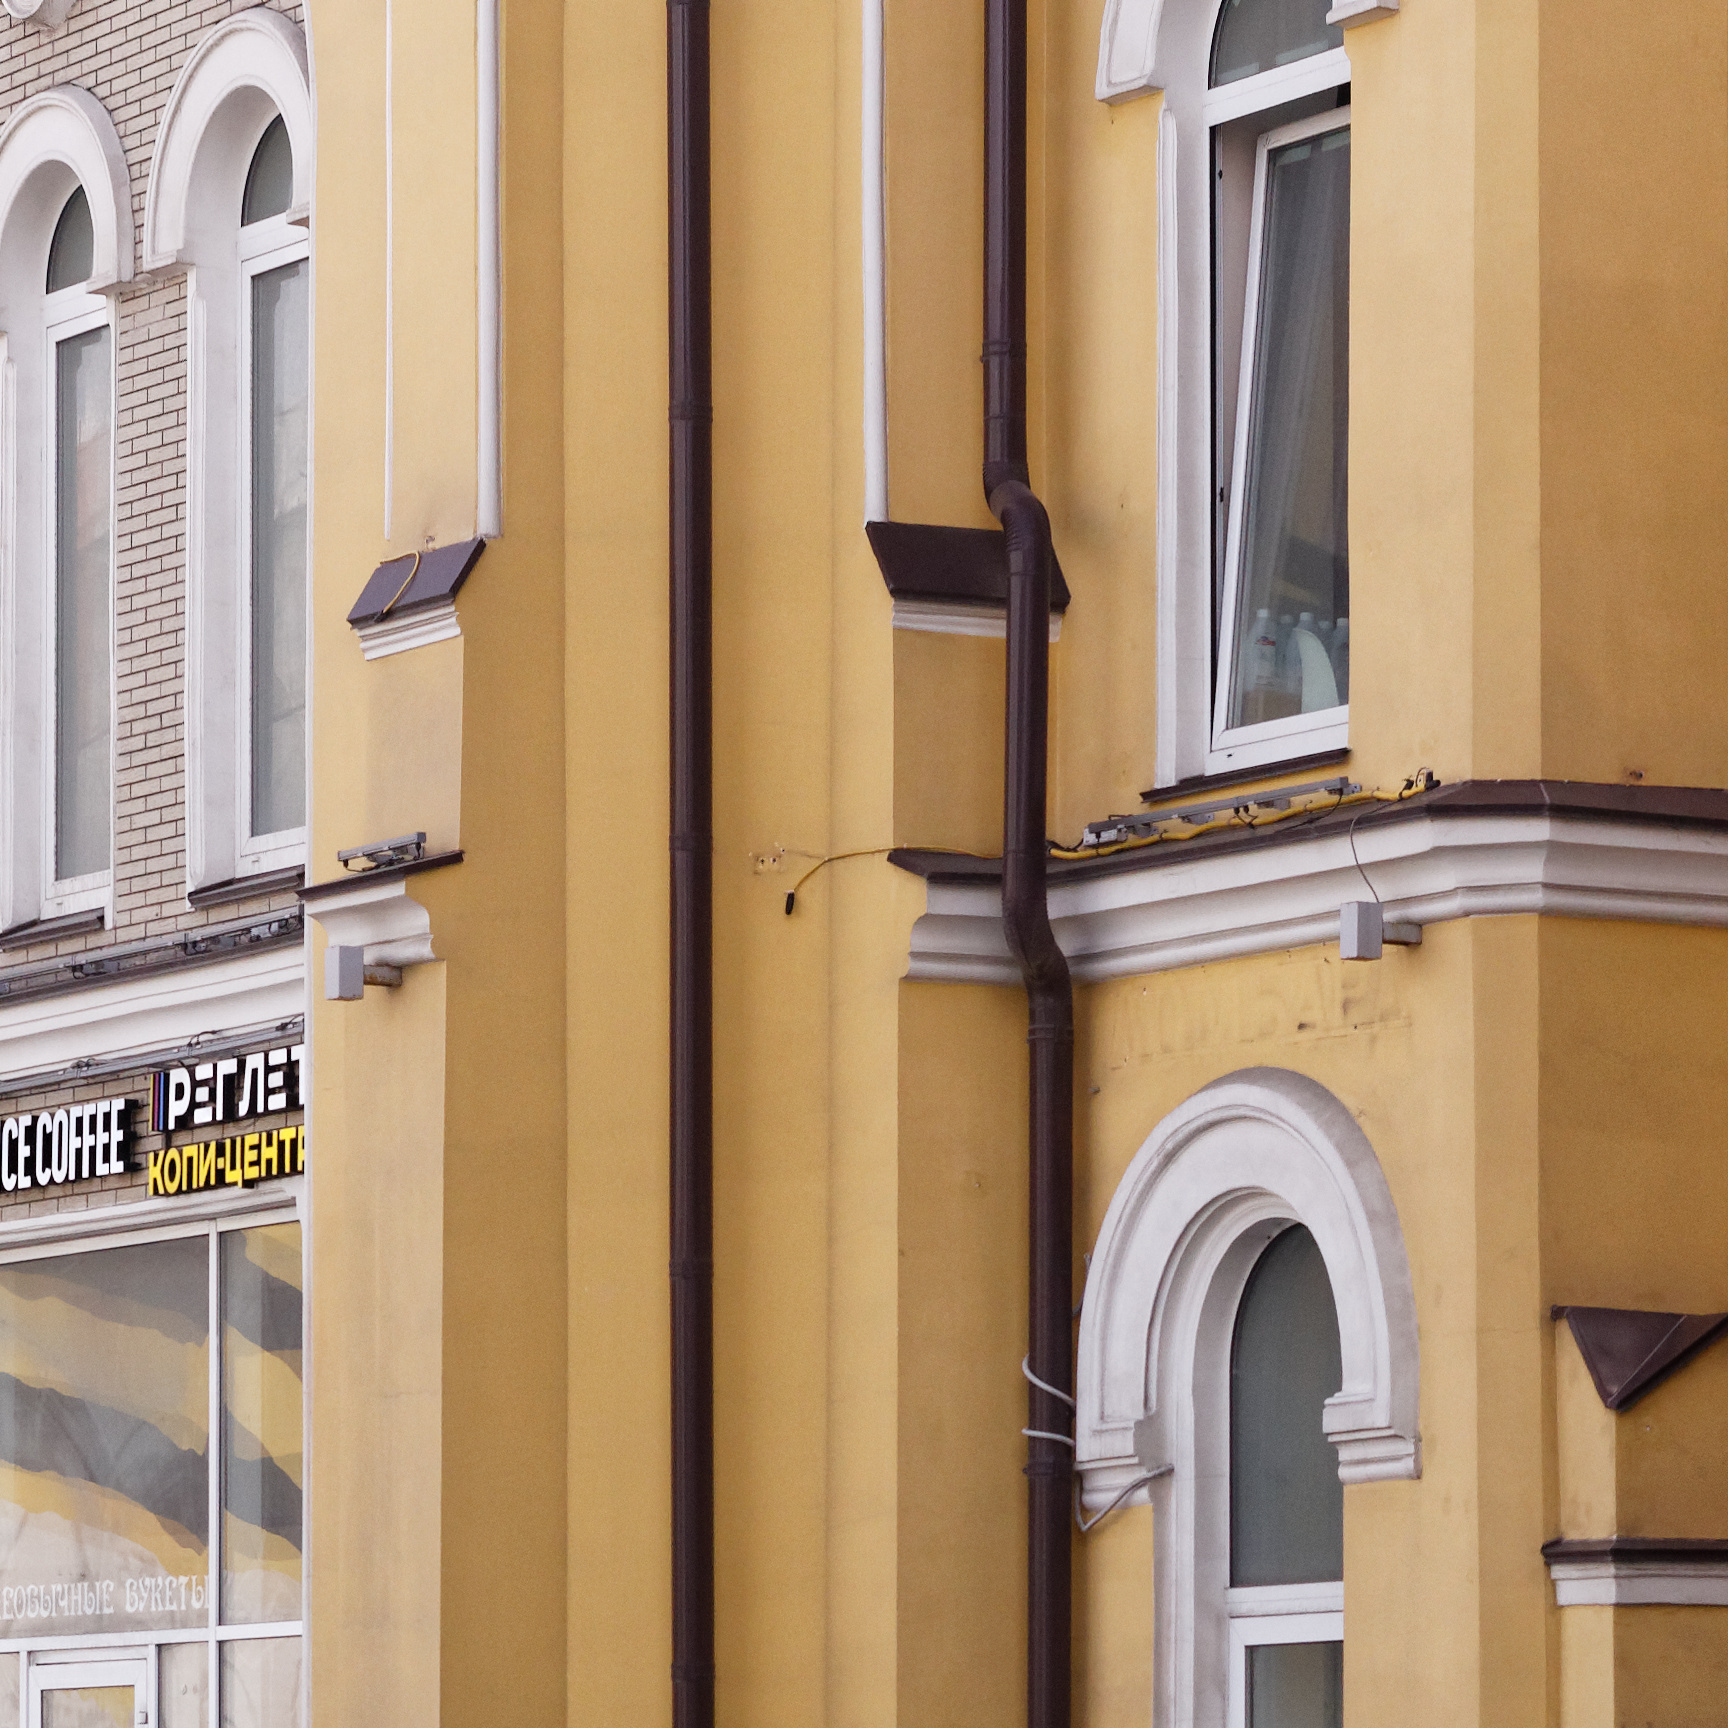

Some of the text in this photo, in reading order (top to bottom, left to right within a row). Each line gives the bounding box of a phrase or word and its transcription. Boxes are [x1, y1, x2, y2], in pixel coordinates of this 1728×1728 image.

[168, 1044, 305, 1131] РЕГЛЕТ
[35, 1098, 125, 1186] COFFEE
[125, 1574, 209, 1613] БУКЕТЫ
